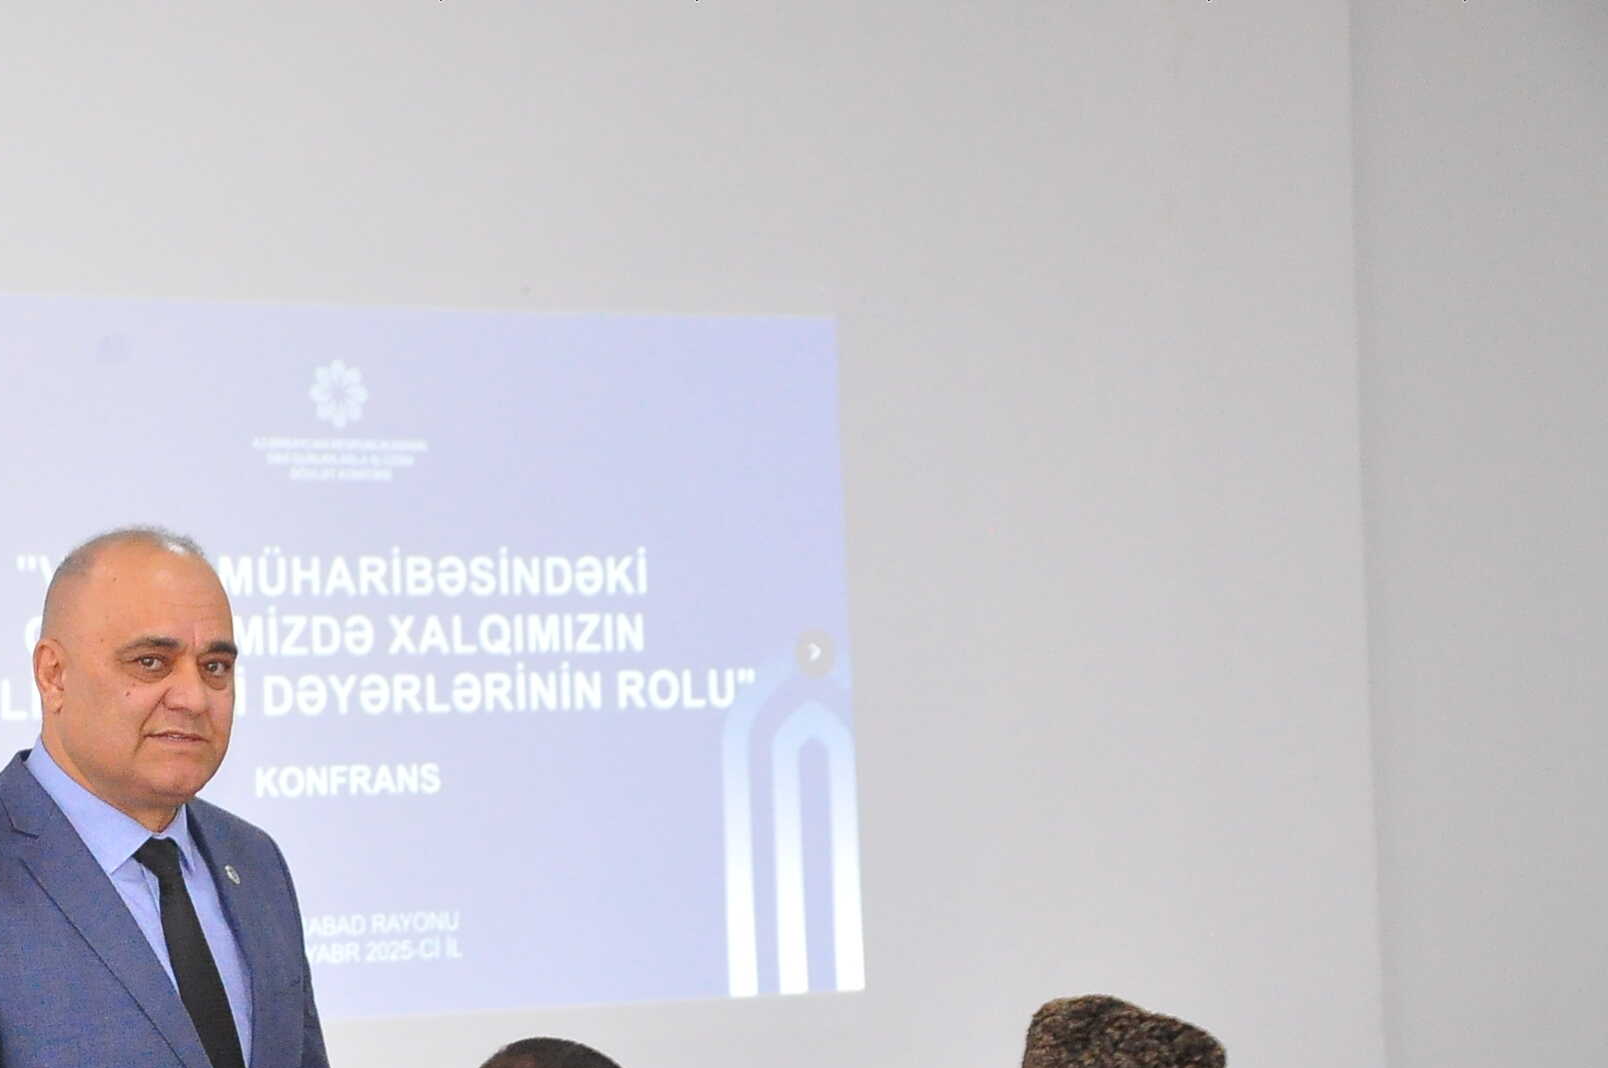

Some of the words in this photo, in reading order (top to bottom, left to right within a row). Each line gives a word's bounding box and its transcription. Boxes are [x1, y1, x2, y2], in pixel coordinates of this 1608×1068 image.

[218, 546, 648, 596] MÜHARİBƏSİNDƏKİ
[388, 612, 645, 656] XALQIMIZIN
[264, 662, 602, 717] DƏYƏRLƏRİNİN
[617, 667, 756, 711] ROLU"
[255, 762, 441, 799] KONFRANS
[302, 914, 366, 936] ABAD
[371, 909, 459, 934] RAYONU
[306, 942, 360, 963] YABR
